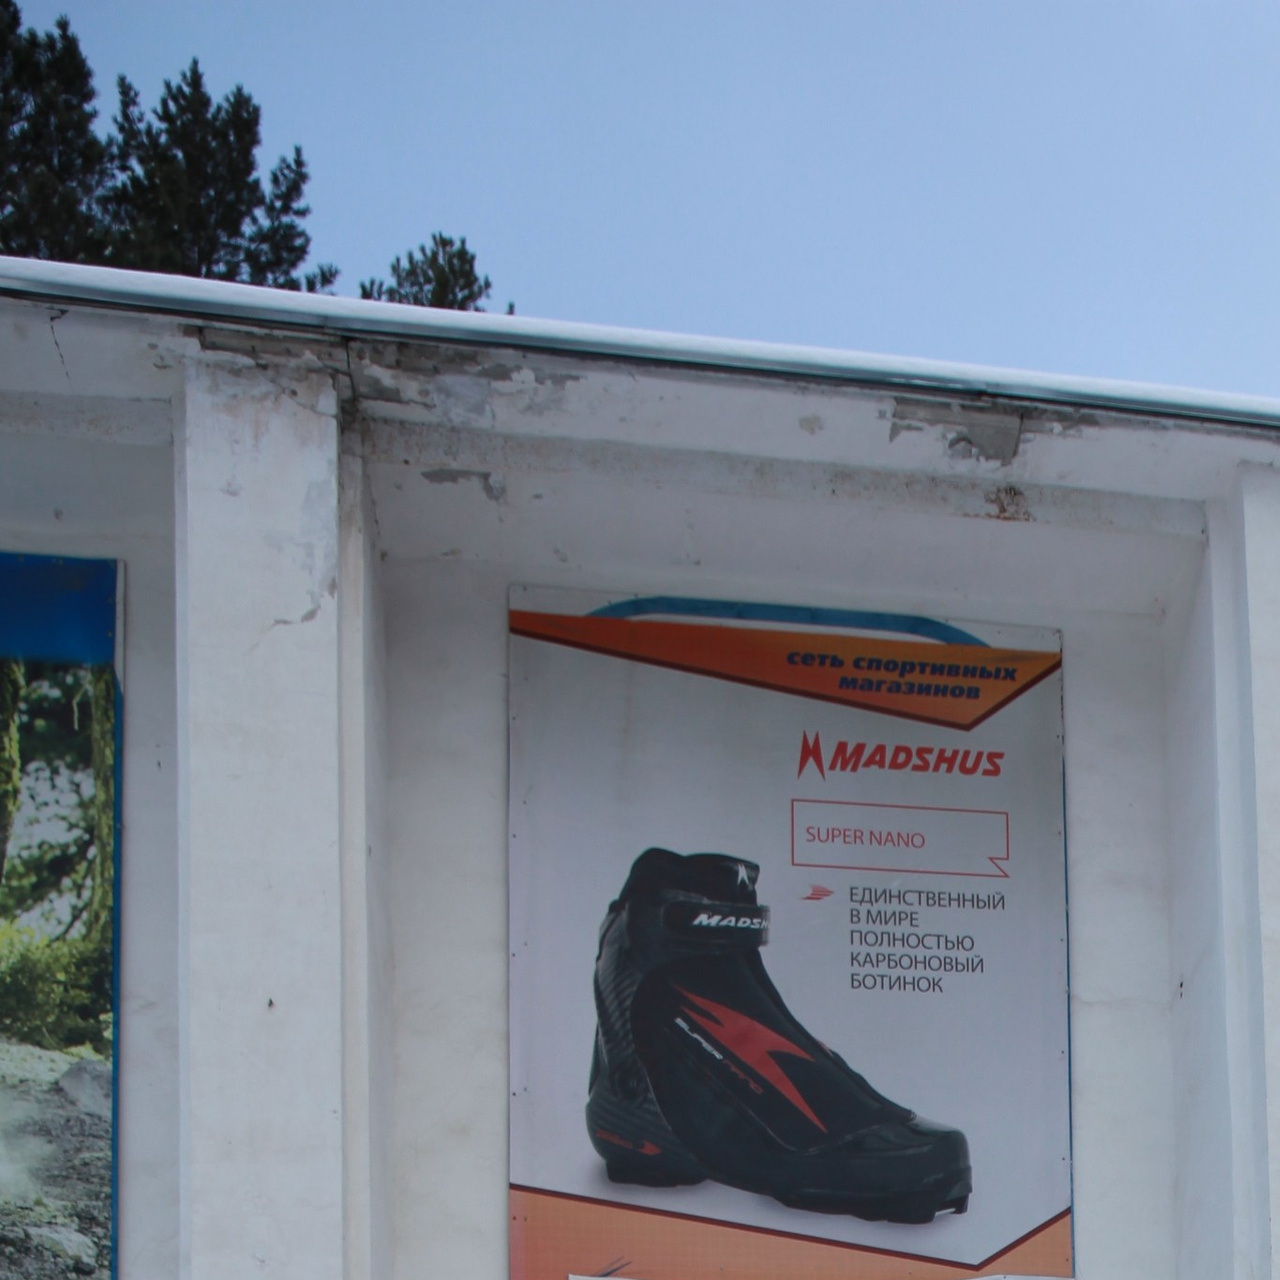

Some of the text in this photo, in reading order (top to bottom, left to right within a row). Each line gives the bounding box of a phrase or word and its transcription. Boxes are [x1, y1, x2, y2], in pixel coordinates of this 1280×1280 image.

[786, 649, 1017, 682] сеть спортивных
[838, 675, 981, 699] магазинов
[828, 740, 1005, 777] MADSHUS
[805, 826, 926, 849] SUPER NANO
[849, 885, 1006, 911] ЕДИНСТВЕННЫЙ
[692, 912, 770, 930] MADSH
[850, 909, 920, 928] В МИРЕ
[849, 930, 975, 952] ПОЛНОСТЬЮ
[849, 951, 985, 974] КАРБОНОВЫЙ
[849, 973, 944, 994] БОТИНОК
